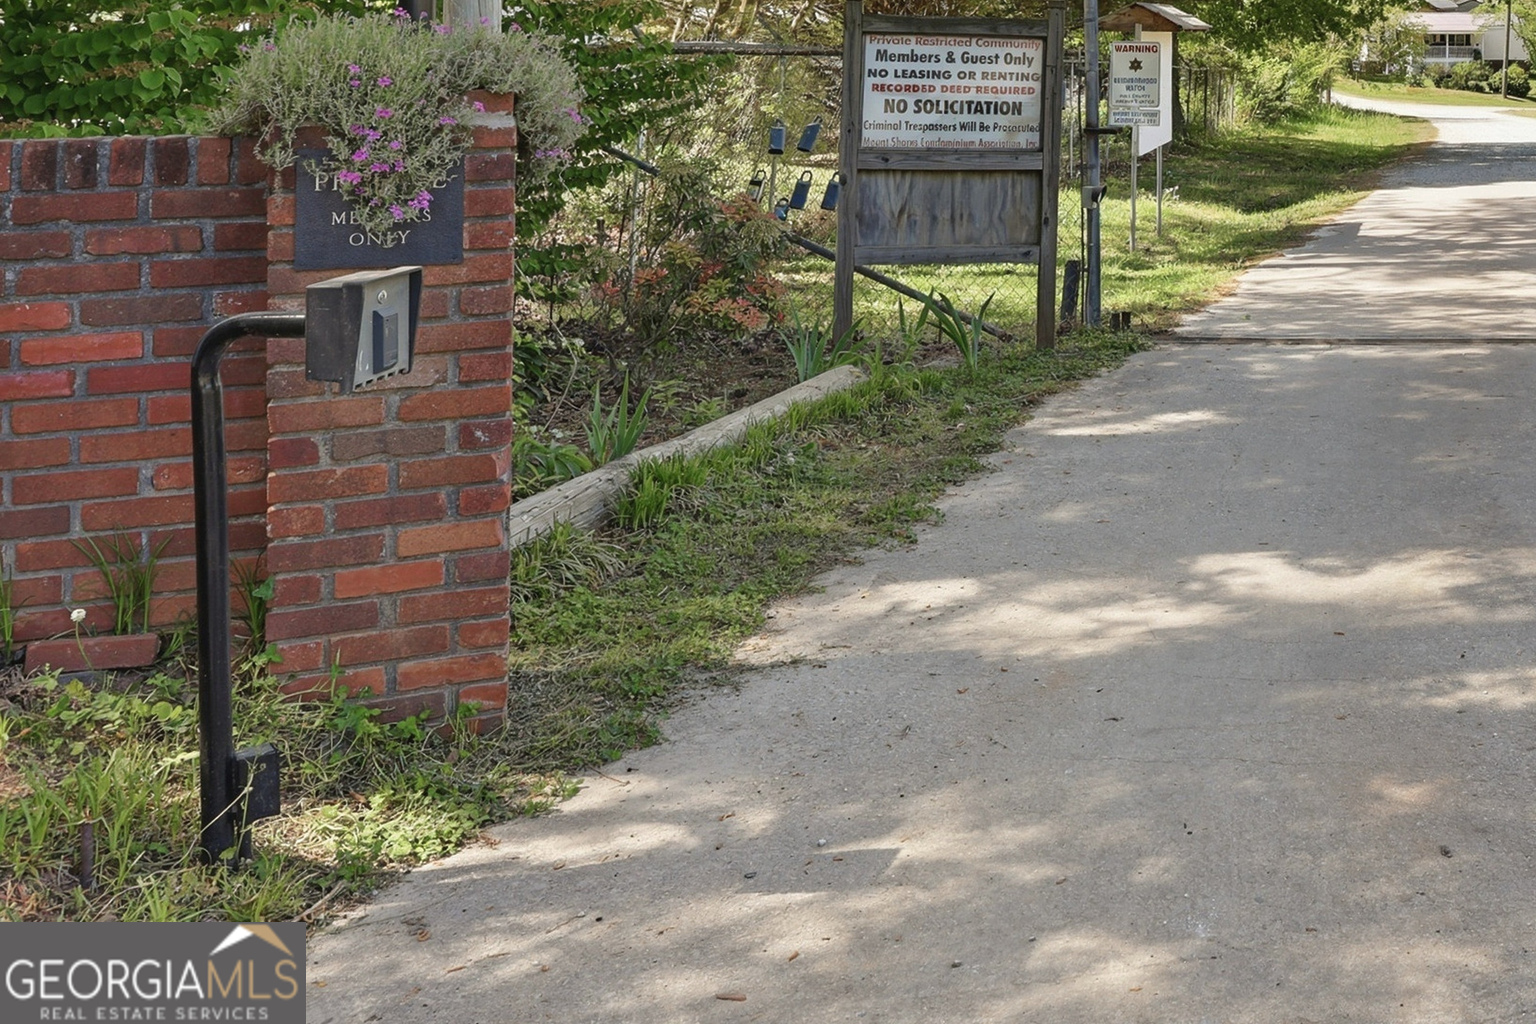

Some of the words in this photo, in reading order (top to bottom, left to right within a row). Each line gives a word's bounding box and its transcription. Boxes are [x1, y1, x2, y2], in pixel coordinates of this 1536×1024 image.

[869, 35, 912, 45] Private
[915, 36, 972, 47] Restricted
[975, 37, 1041, 51] Community
[1114, 45, 1158, 53] WARNING
[875, 48, 941, 63] Members
[945, 50, 956, 64] &
[960, 51, 1000, 65] Guest
[1003, 51, 1035, 68] Only
[867, 68, 889, 78] NO
[893, 69, 952, 80] LEASING
[957, 70, 977, 81] OR
[980, 71, 1041, 82] RENTING
[871, 83, 937, 93] RECORDED
[940, 84, 971, 94] DEED
[976, 85, 1036, 95] REQUIRED
[883, 98, 908, 114] NO
[913, 98, 1023, 116] SOLICITATION
[863, 119, 902, 131] Criminal
[904, 120, 957, 133] Trespassers
[959, 121, 977, 132] Will
[978, 121, 991, 132] Be
[349, 229, 411, 246] ONY
